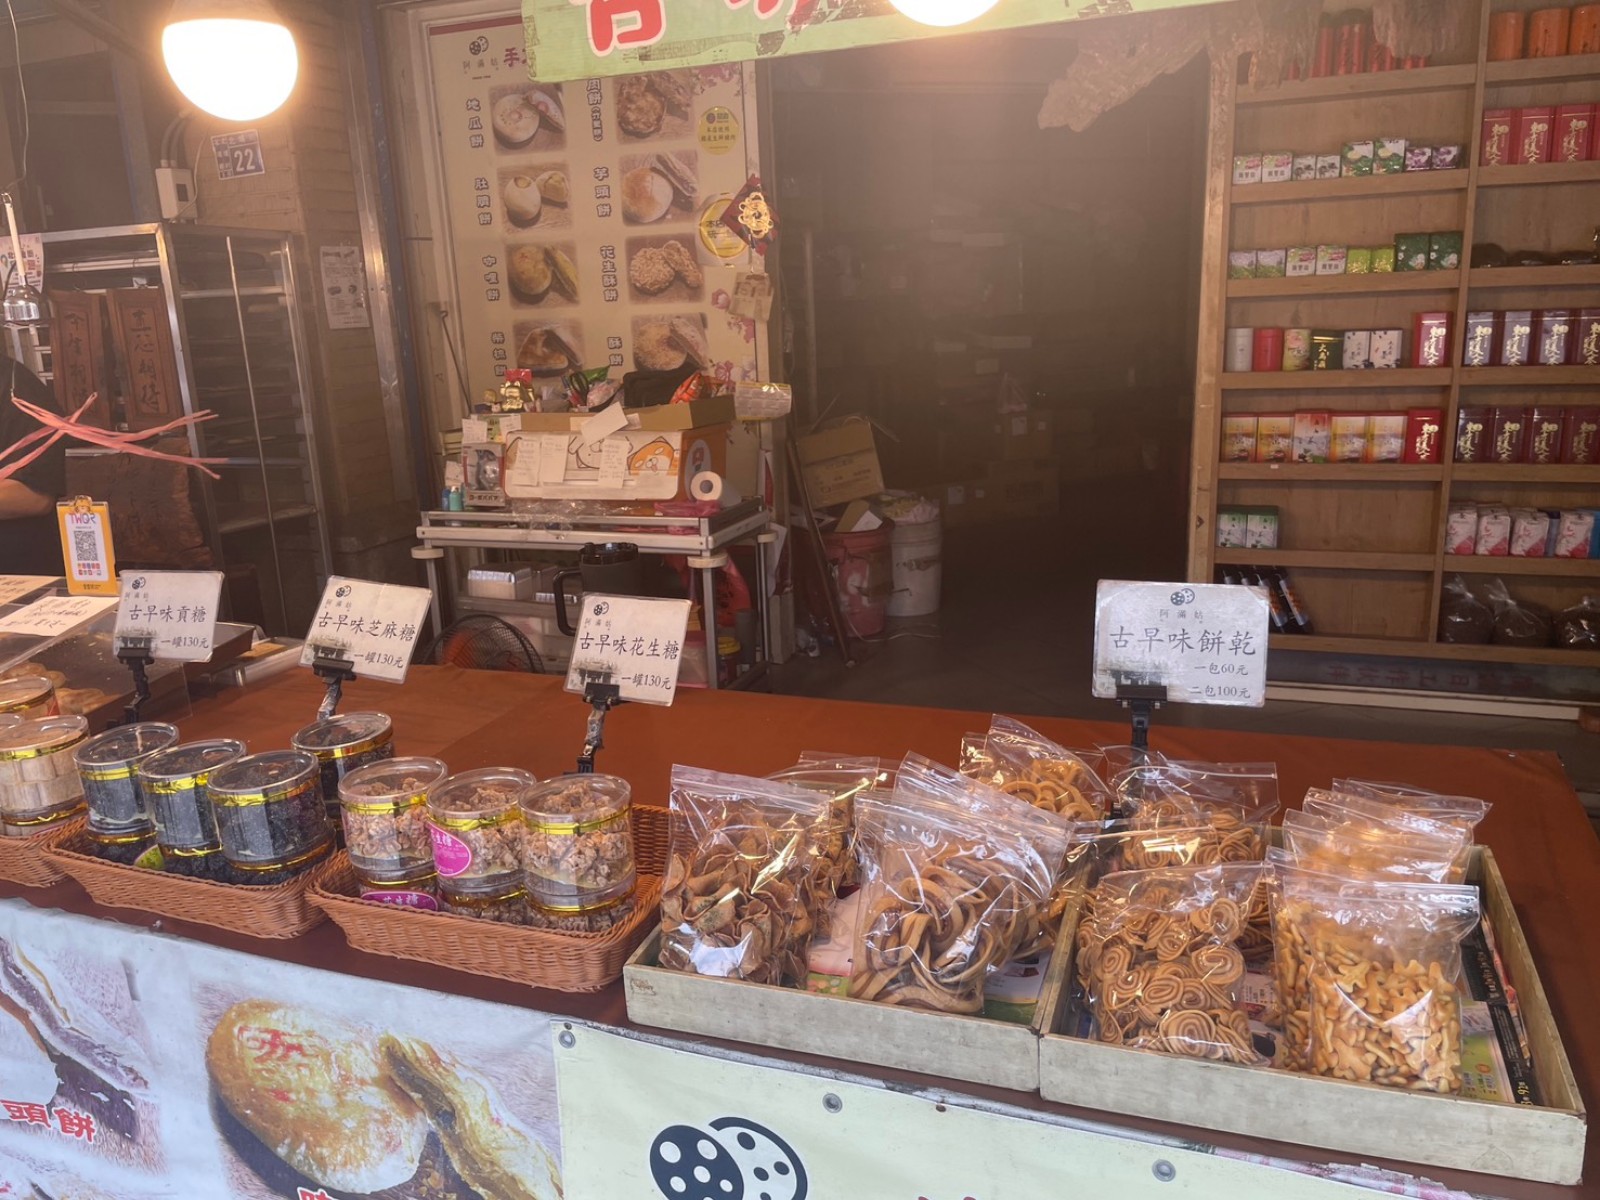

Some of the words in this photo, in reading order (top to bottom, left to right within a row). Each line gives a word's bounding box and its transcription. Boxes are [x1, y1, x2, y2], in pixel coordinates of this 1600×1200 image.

[234, 149, 256, 172] 22
[594, 166, 612, 217] 芋頭餅
[600, 245, 618, 301] 花生酥餅
[129, 605, 207, 623] 古早味貢糖
[318, 612, 416, 641] 古早味芝麻糖
[160, 636, 210, 649] 一罐130元
[580, 632, 679, 660] 古早味花生糖
[1110, 625, 1256, 657] 古早味餅乾
[354, 651, 404, 669] 一罐130元
[1194, 662, 1249, 676] 一包60元
[621, 673, 672, 690] 一罐130元
[1190, 685, 1251, 698] 二包100元
[1, 1099, 95, 1142] 頭餅
